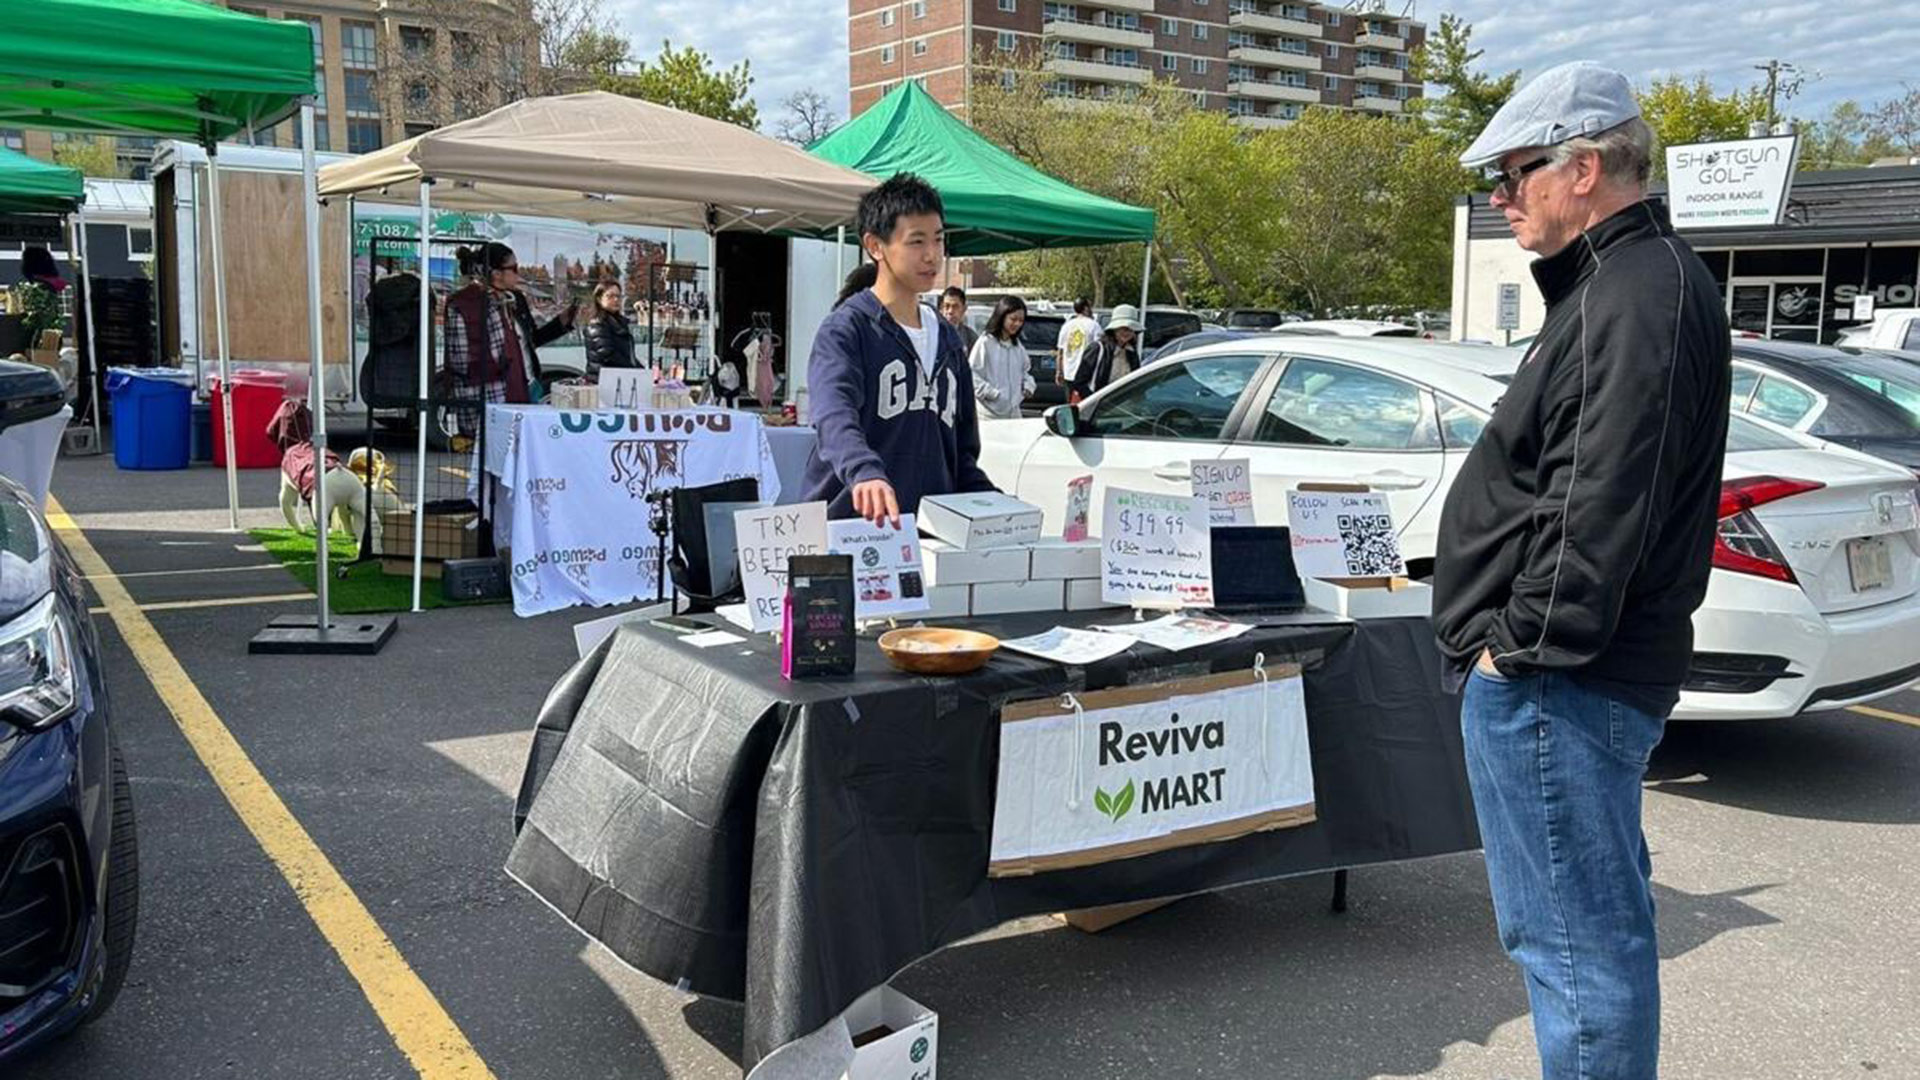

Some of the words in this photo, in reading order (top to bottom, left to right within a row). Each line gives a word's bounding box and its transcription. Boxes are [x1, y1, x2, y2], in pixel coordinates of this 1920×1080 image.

[1676, 147, 1780, 169] SHOTGUN
[1698, 166, 1758, 184] GOLF
[1686, 193, 1726, 203] INDOOR
[1729, 190, 1764, 201] RANGE
[1834, 284, 1916, 303] SHO
[1291, 496, 1328, 508] FOLLOW
[1302, 509, 1318, 520] US
[753, 513, 800, 539] TRY
[756, 597, 781, 617] RE
[1099, 712, 1224, 766] Reviva
[1141, 768, 1226, 814] MART
